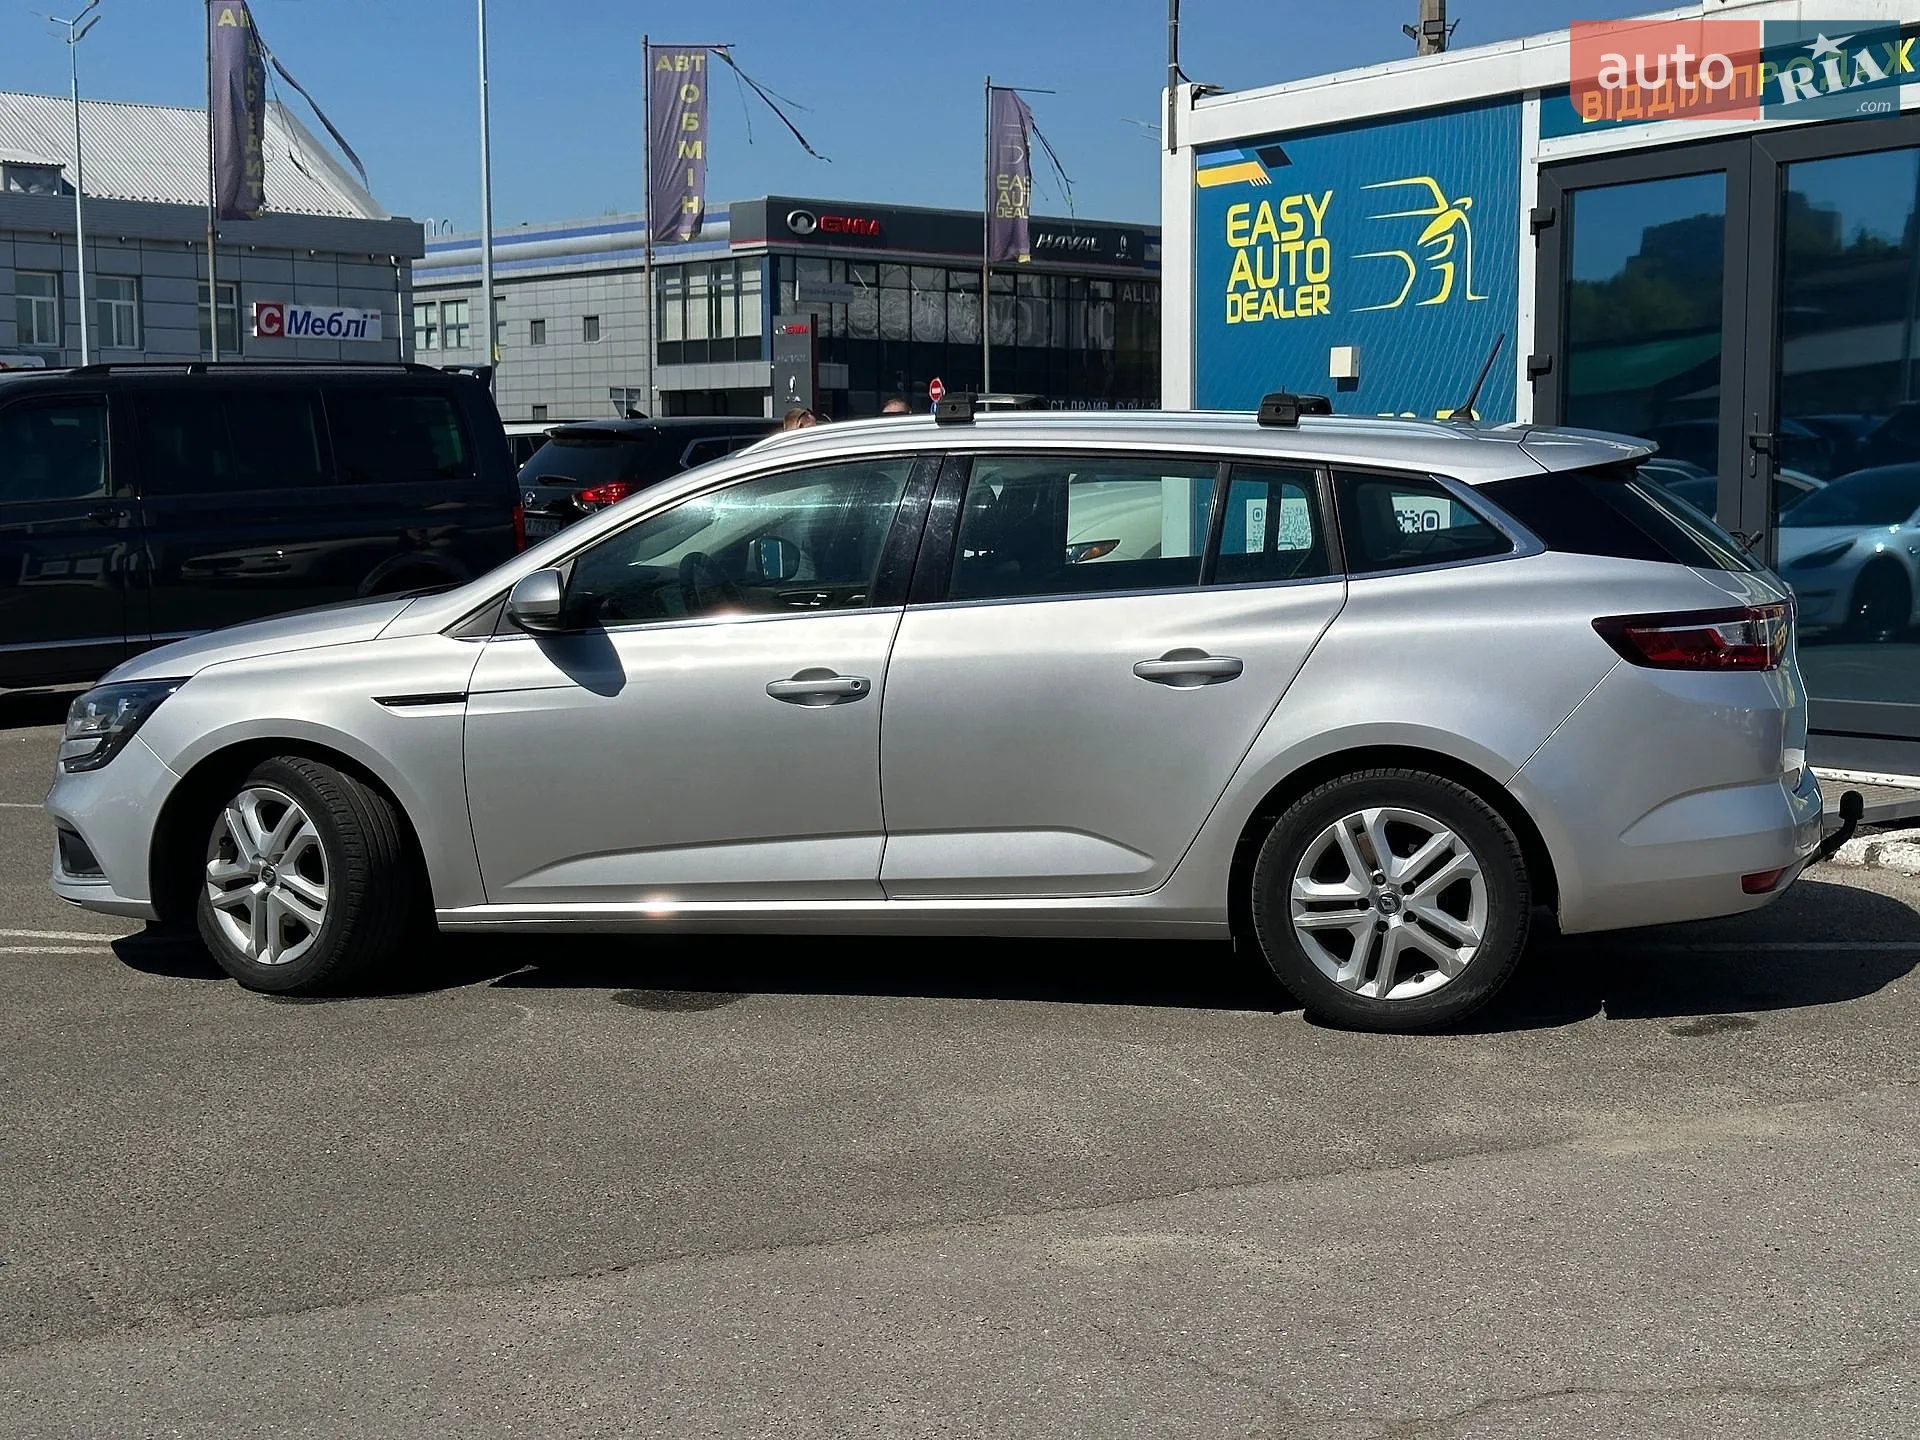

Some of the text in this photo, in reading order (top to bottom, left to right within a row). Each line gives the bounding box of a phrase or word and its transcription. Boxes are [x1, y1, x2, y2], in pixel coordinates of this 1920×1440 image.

[1582, 71, 1714, 124] ВІДДІЛ
[821, 215, 880, 236] GWM
[1226, 190, 1334, 248] EASY
[1036, 233, 1103, 252] HAVAL
[1226, 238, 1331, 293] AUTO
[1226, 283, 1331, 325] DEALER
[287, 309, 368, 338] Меблі
[1046, 398, 1109, 411] СТ-ДРАЙВ
